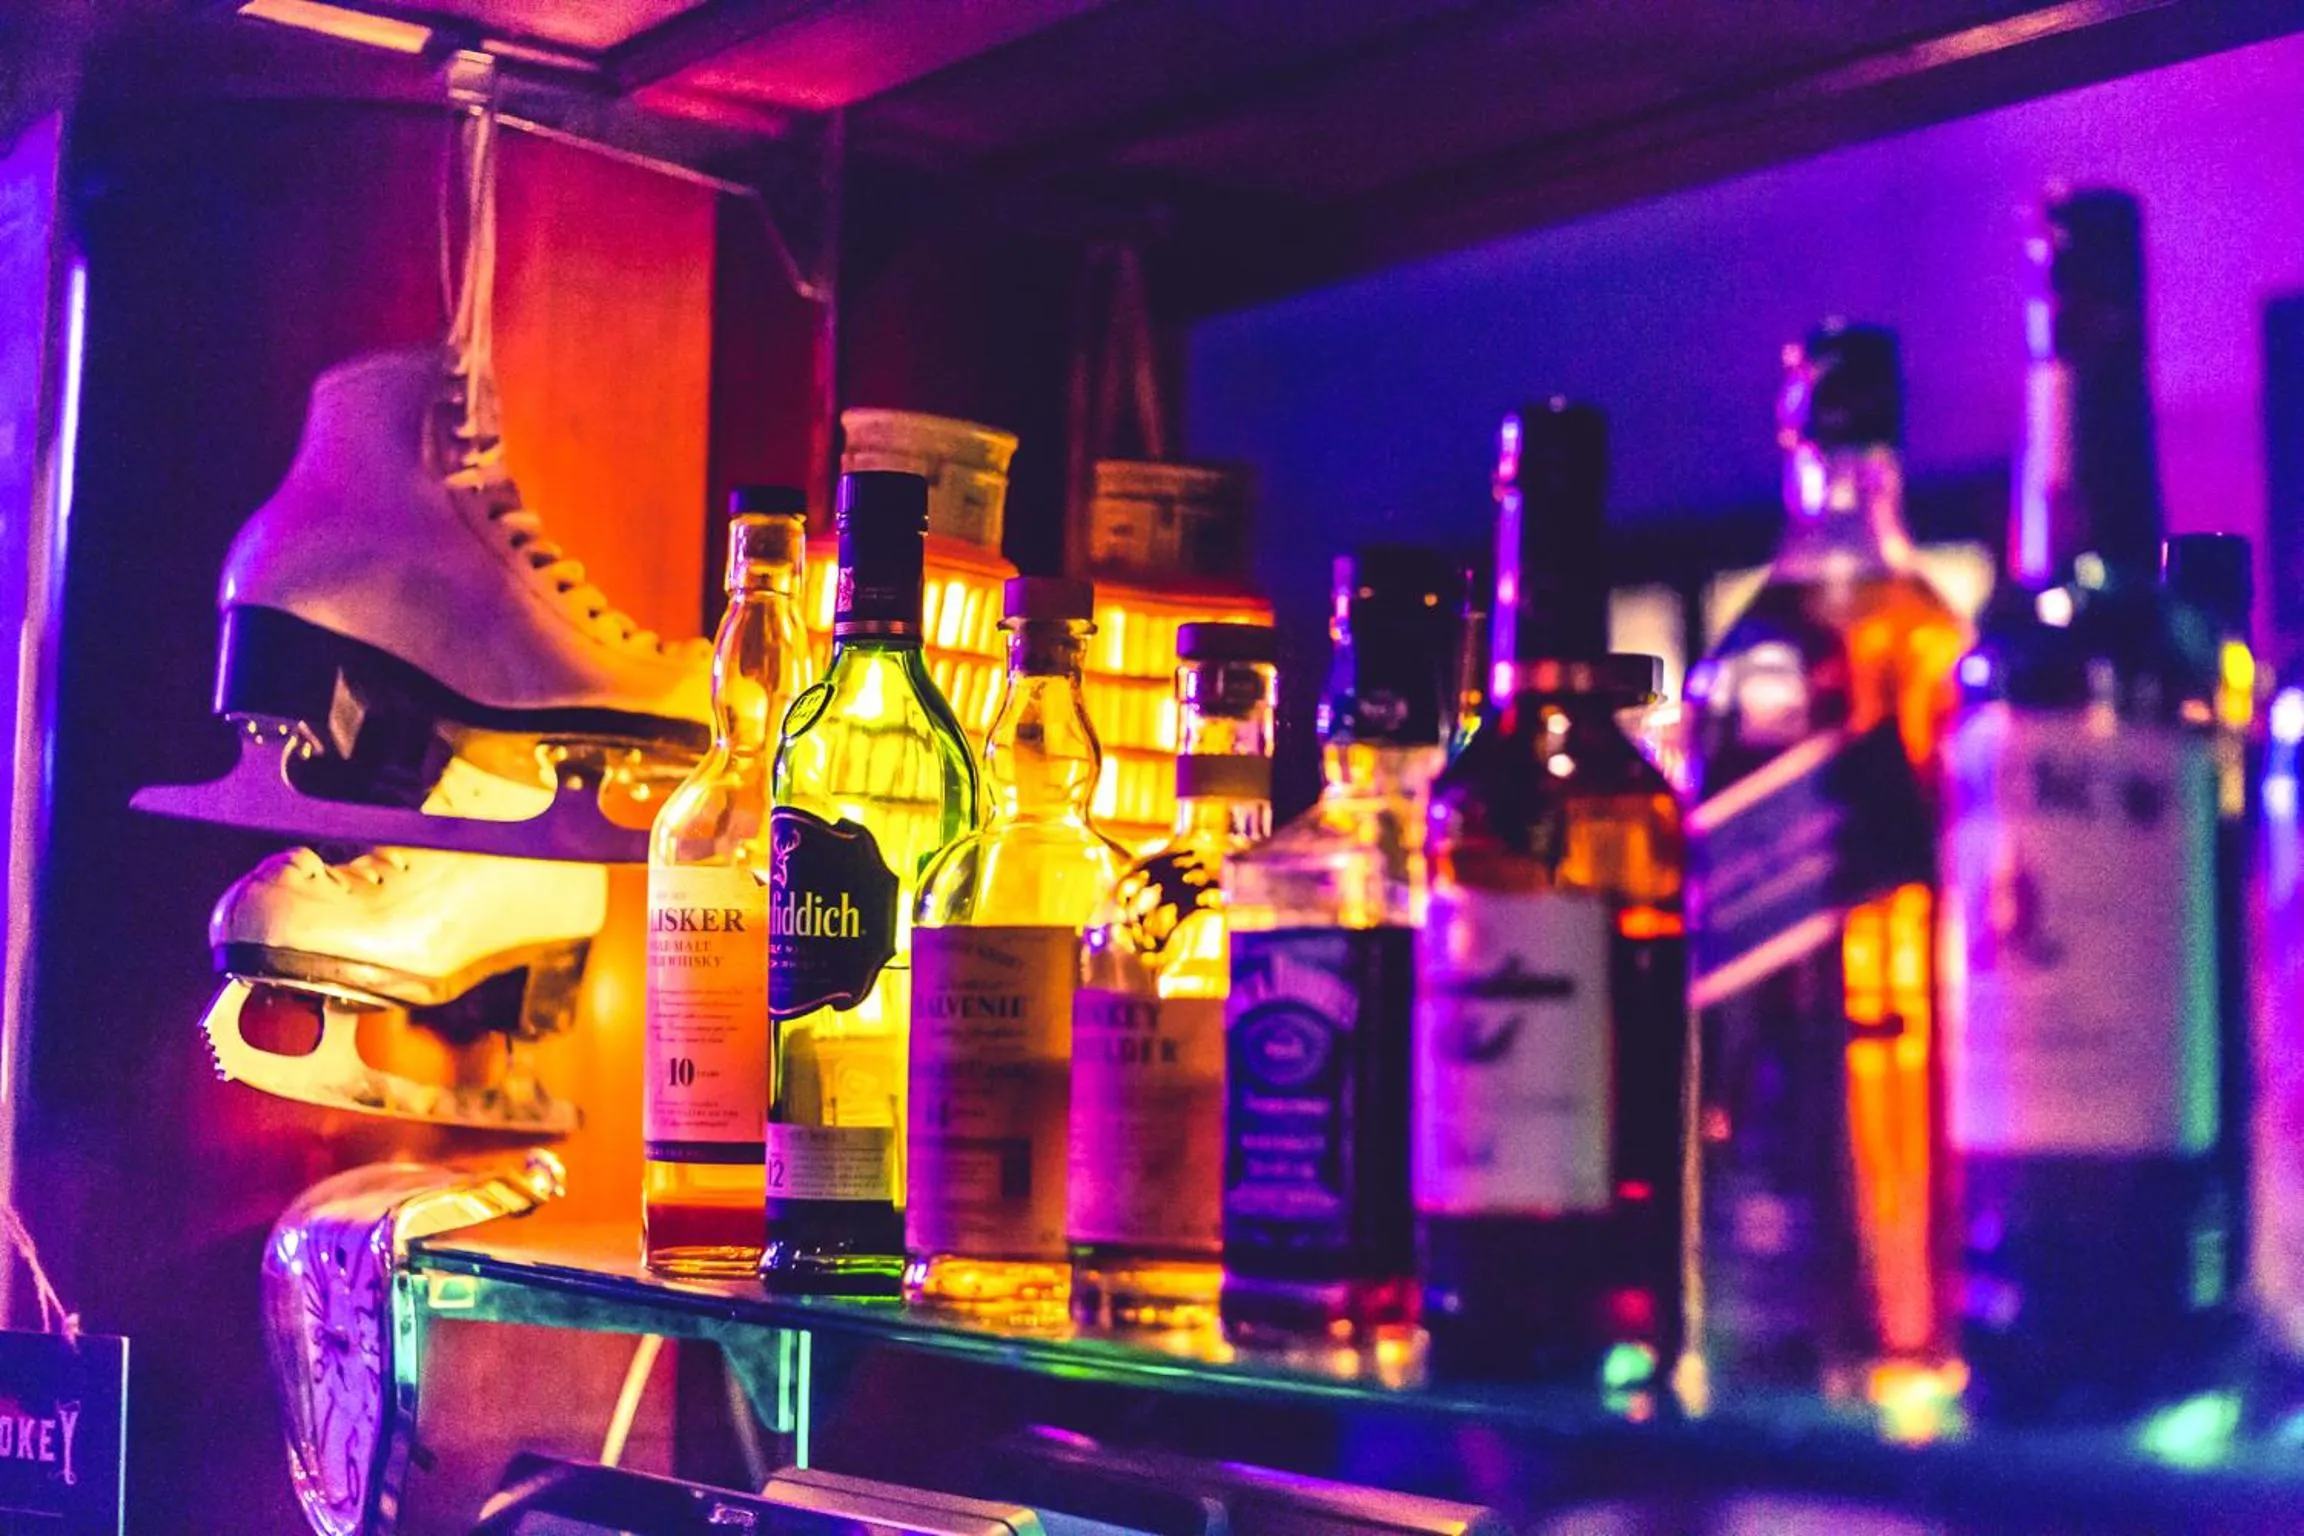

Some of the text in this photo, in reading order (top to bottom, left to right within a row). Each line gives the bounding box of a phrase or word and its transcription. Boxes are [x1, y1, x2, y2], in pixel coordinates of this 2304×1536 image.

[673, 940, 712, 953] MALT
[668, 955, 724, 968] WHISKY
[669, 1058, 695, 1086] 10
